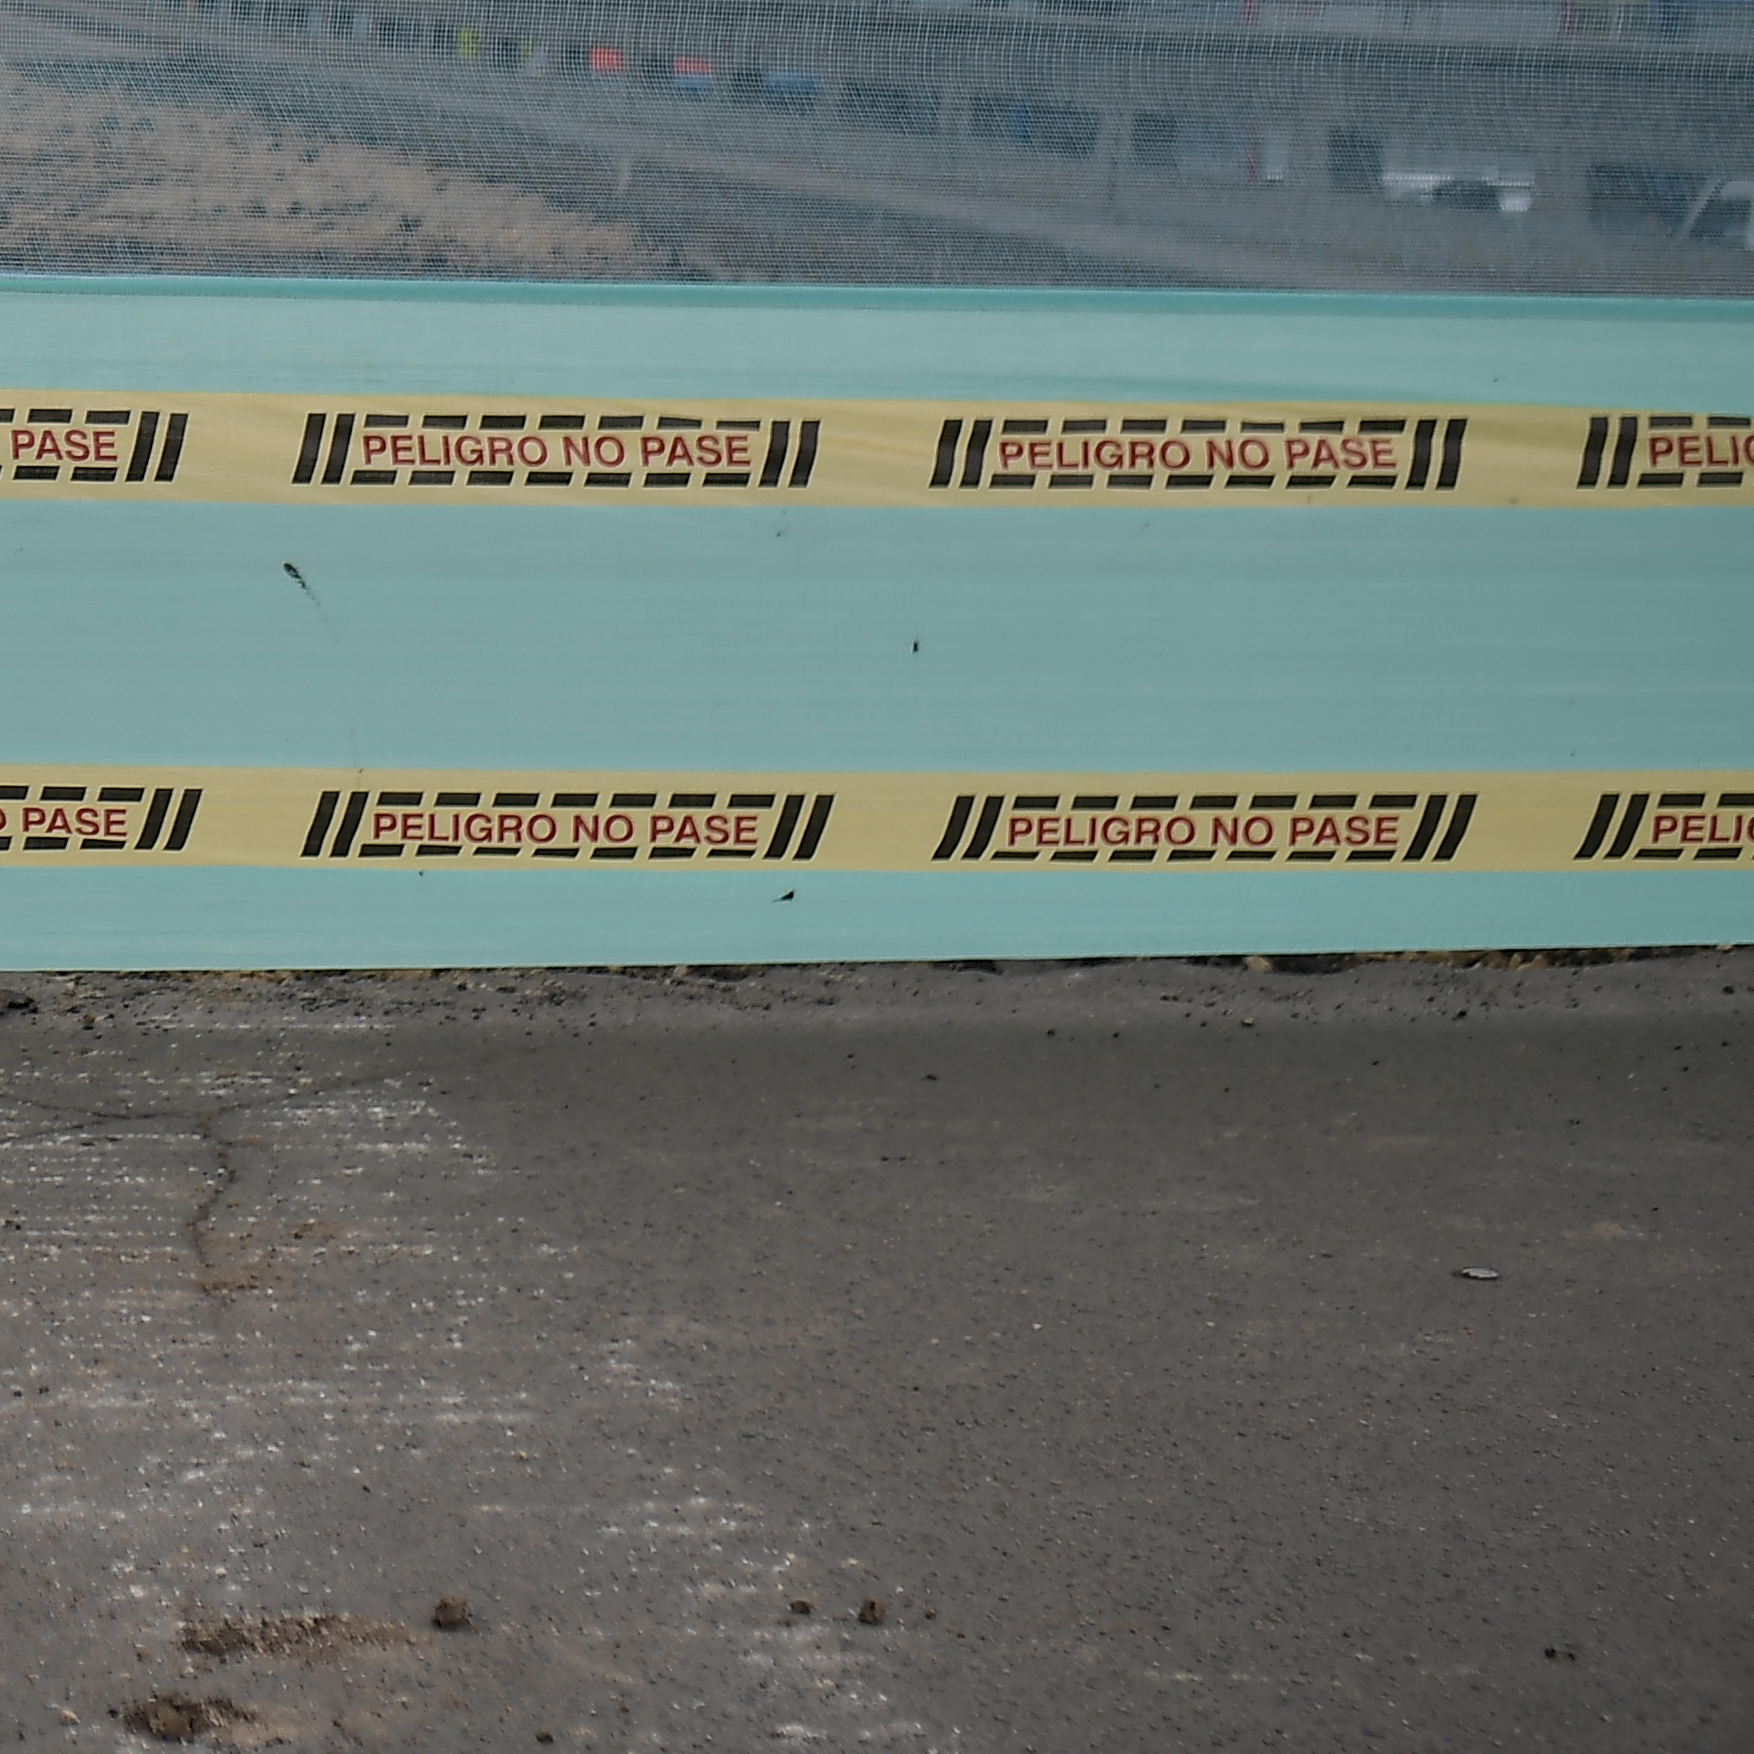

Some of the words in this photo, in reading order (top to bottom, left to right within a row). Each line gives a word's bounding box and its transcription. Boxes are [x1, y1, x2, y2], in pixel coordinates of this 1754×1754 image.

[12, 429, 118, 462] PASE
[364, 435, 548, 466] PELIGRO
[563, 436, 625, 467] NO
[641, 435, 751, 467] PASE
[1000, 439, 1191, 470] PELIGRO
[1207, 438, 1270, 470] NO
[1286, 438, 1396, 470] PASE
[22, 807, 128, 838] PASE
[373, 812, 557, 844] PELIGRO
[573, 813, 634, 844] NO
[650, 814, 758, 846] PASE
[1009, 816, 1196, 846] PELIGRO
[1211, 816, 1273, 847] NO
[1289, 816, 1399, 847] PASE
[1652, 814, 1754, 843] PELI
